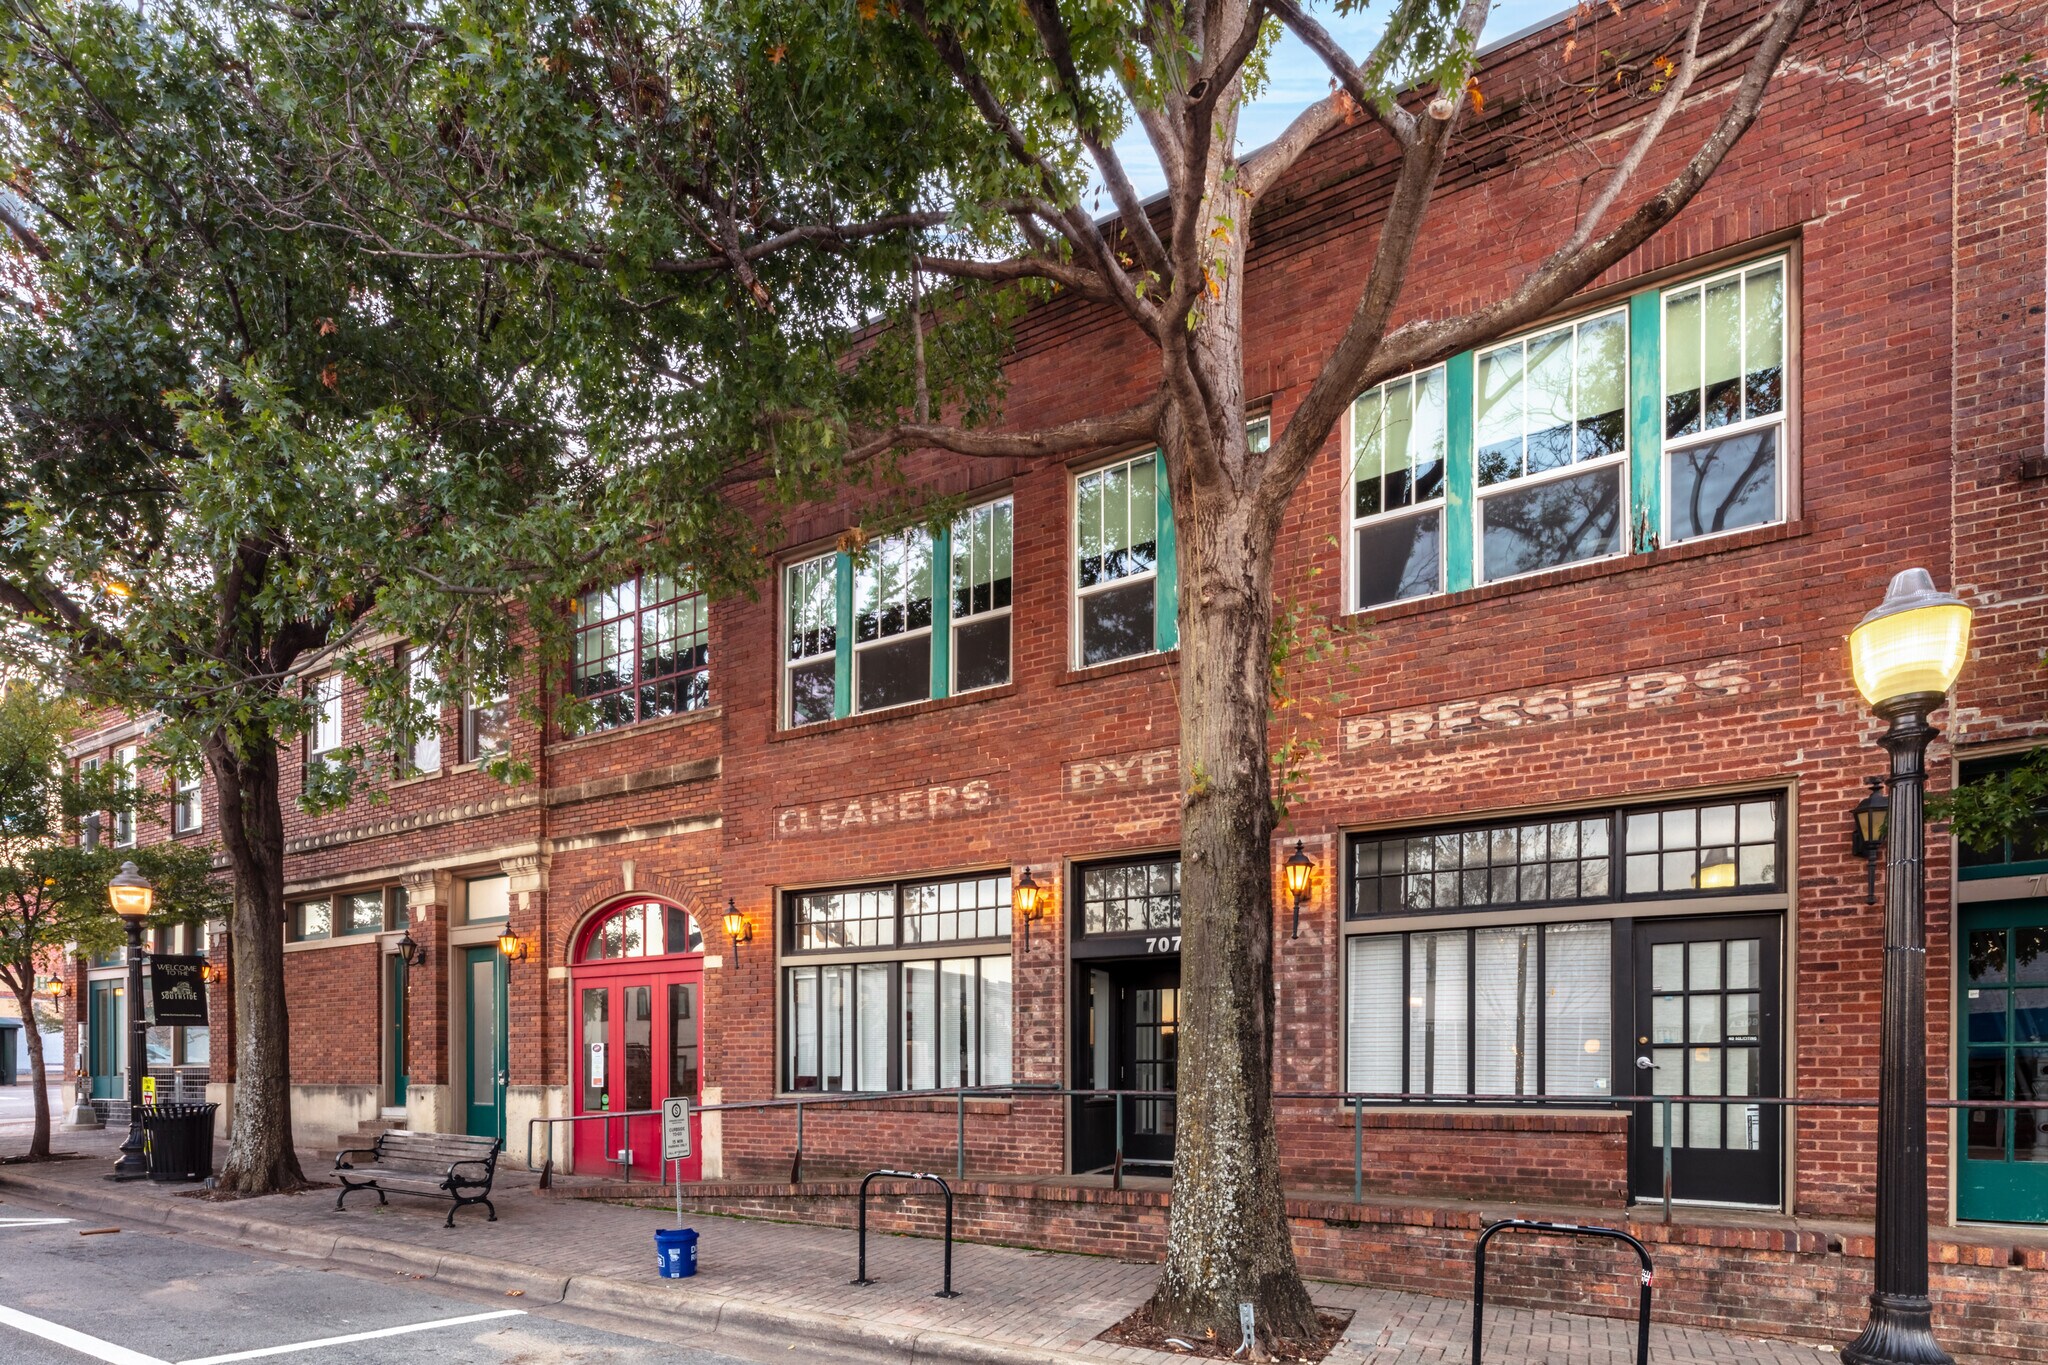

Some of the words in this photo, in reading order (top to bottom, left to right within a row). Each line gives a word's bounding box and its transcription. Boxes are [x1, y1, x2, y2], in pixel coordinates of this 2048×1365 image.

[778, 779, 990, 834] CLEANERS
[1145, 936, 1181, 953] 707
[157, 964, 197, 972] WELCOME
[161, 990, 198, 1001] SOUTHSIDE
